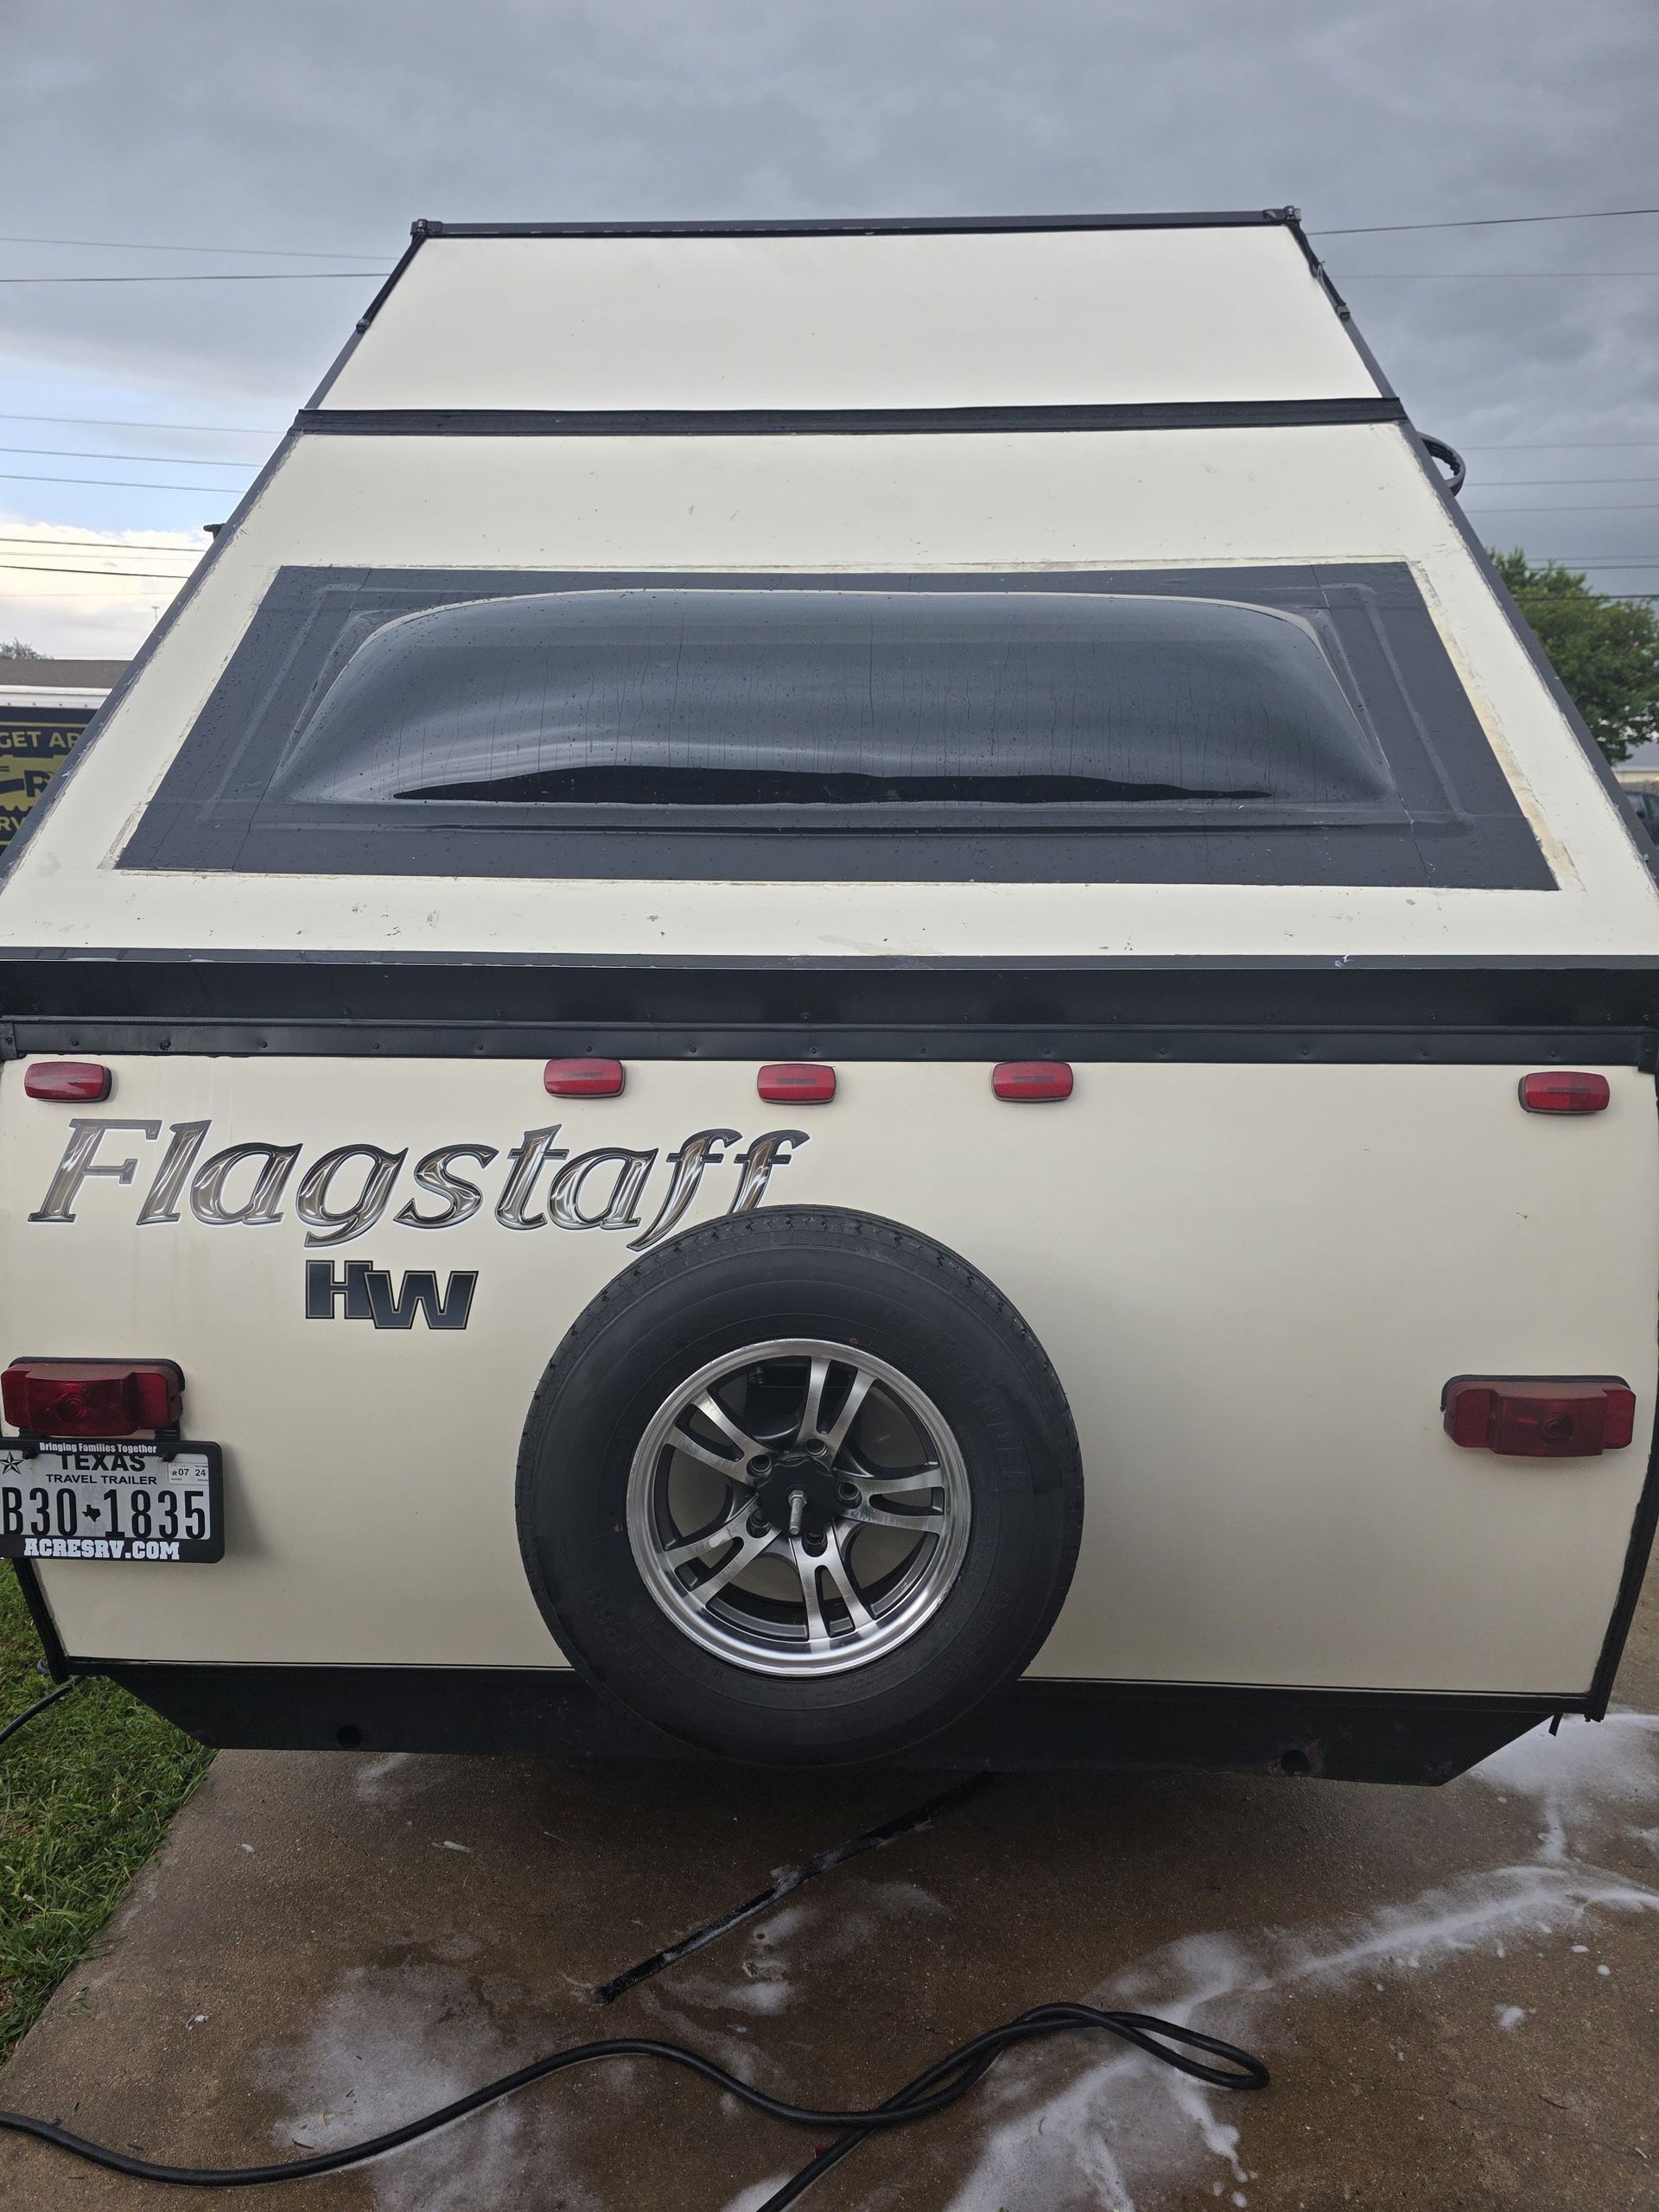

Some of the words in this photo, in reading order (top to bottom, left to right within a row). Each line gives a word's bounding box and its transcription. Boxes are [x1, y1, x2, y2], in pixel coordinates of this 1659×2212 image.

[27, 1118, 810, 1251] Flagstaff
[305, 1260, 480, 1330] HW
[39, 1442, 78, 1452] Bringing
[79, 1443, 116, 1452] Families
[118, 1444, 157, 1454] Together
[56, 1453, 146, 1472] TEXAS
[46, 1474, 97, 1484] TRAVEL
[100, 1475, 157, 1485] TRAILER
[24, 1538, 180, 1560] ACRESRV.COM
